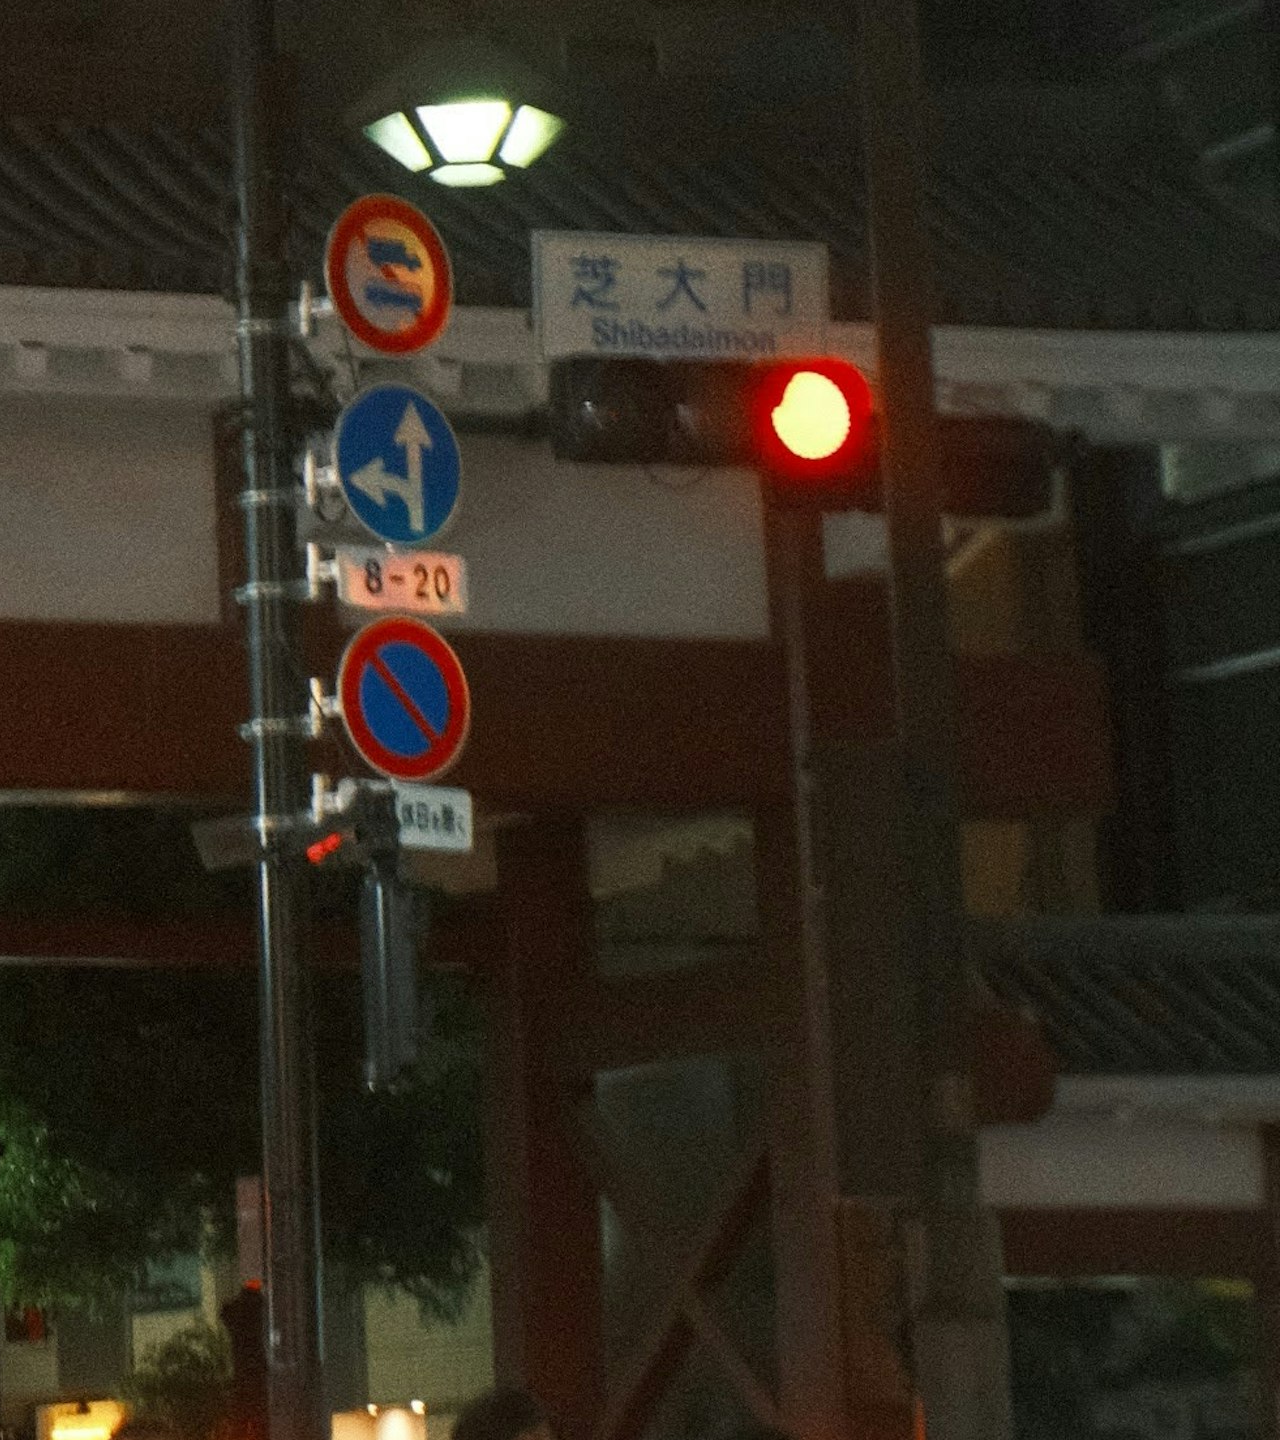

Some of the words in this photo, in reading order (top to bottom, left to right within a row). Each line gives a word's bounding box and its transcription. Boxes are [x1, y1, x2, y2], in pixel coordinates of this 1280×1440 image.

[570, 252, 793, 315] 芝大門
[592, 316, 777, 353] Shibadaimon
[365, 557, 451, 602] 8-20
